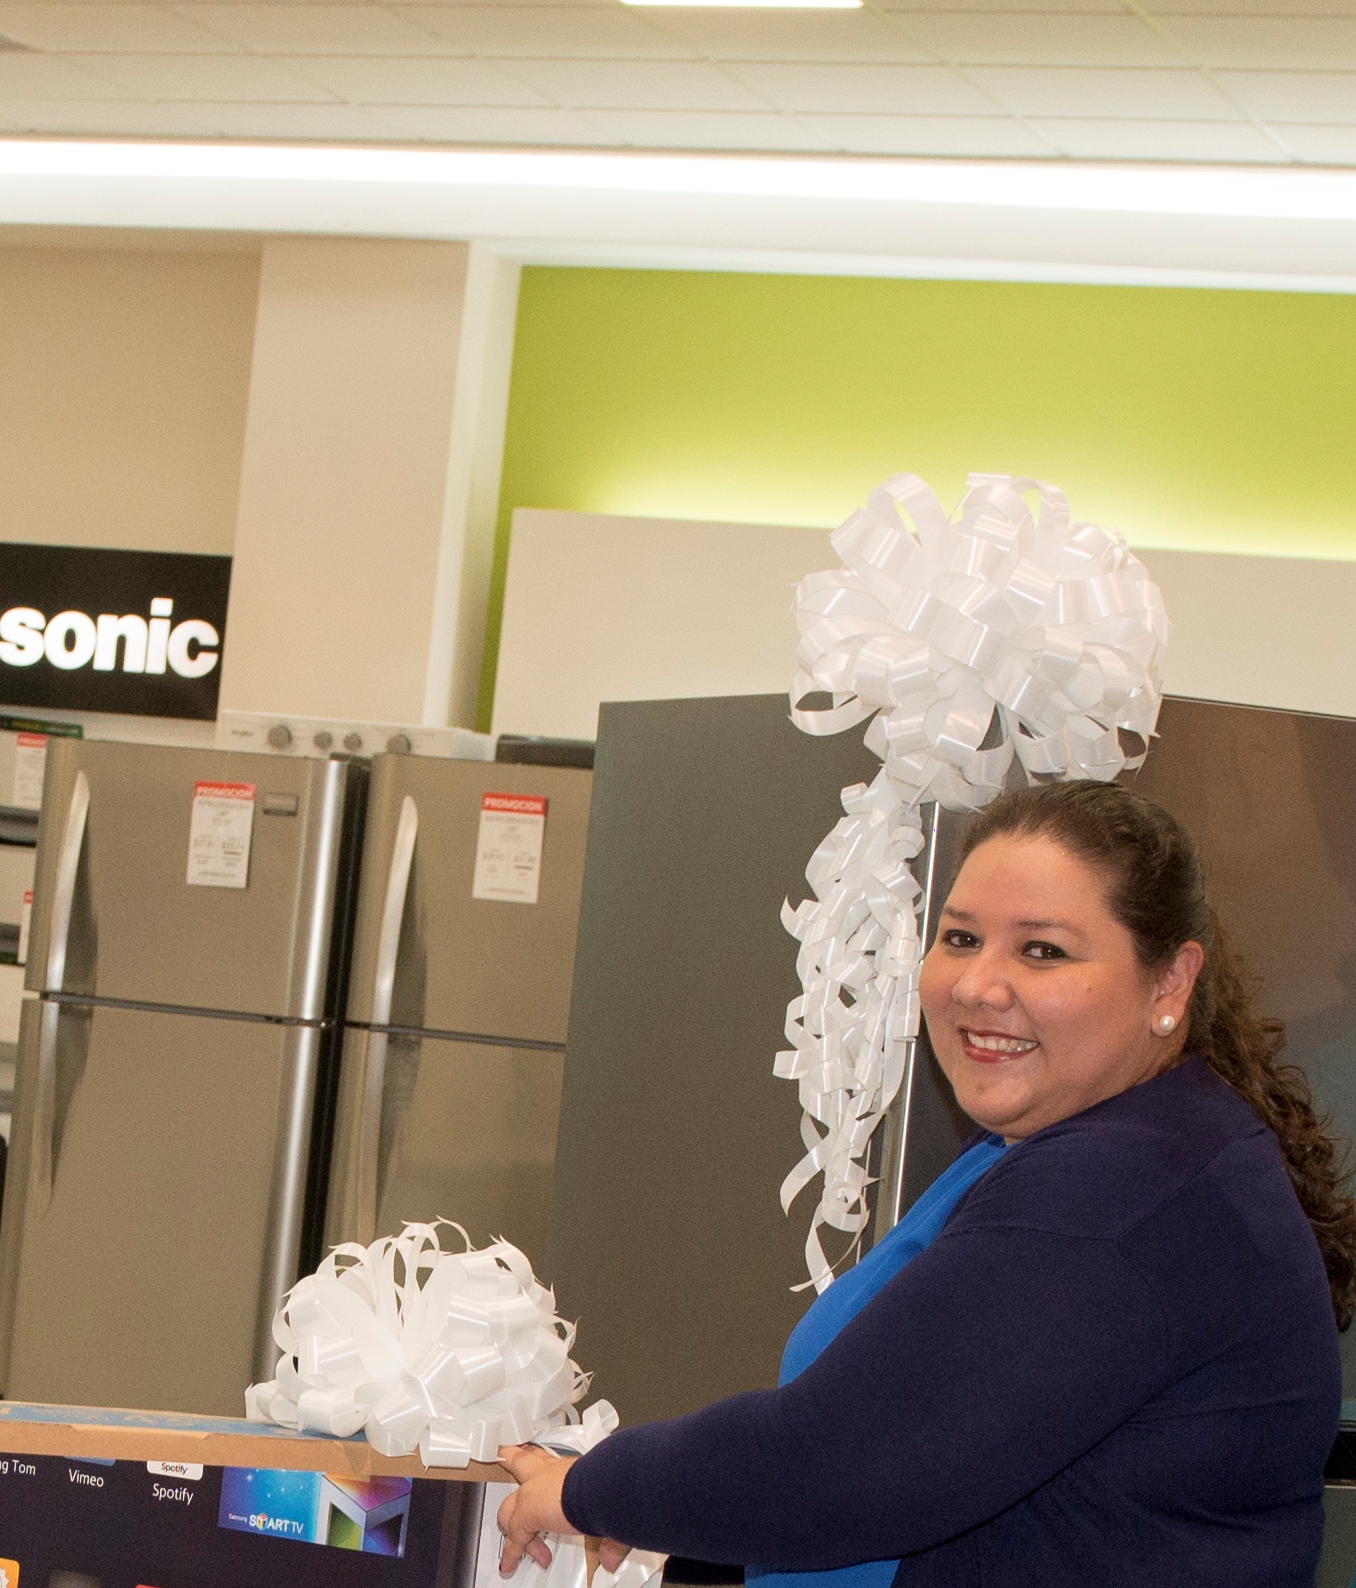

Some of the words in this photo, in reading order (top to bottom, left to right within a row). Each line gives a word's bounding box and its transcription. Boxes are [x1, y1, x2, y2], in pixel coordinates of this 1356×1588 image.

[484, 797, 543, 811] PROMOCION
[12, 1458, 35, 1476] Tom
[68, 1469, 104, 1488] Vimeo
[152, 1483, 194, 1505] Spotify
